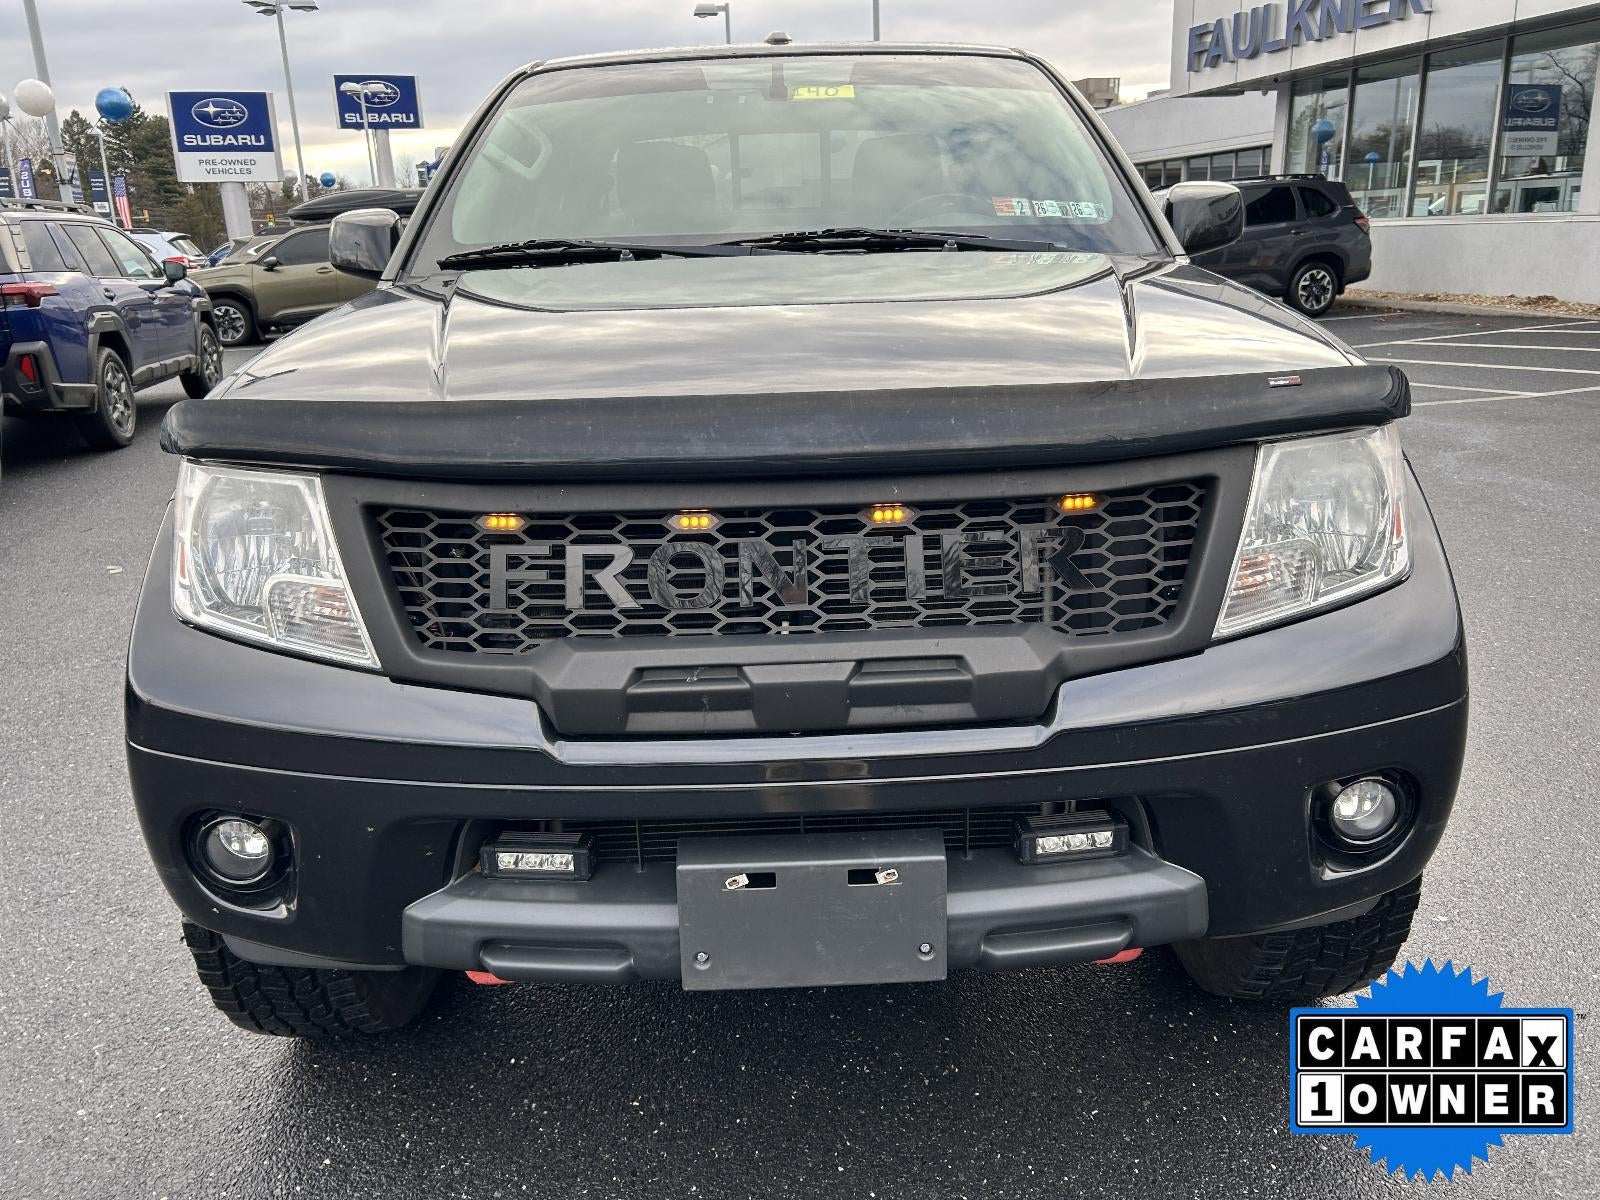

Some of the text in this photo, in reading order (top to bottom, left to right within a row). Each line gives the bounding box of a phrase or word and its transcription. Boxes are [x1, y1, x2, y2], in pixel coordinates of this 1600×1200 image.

[344, 113, 415, 123] SUBARU
[183, 134, 265, 146] SUBARU
[198, 158, 257, 166] PRE-OWNED
[204, 167, 252, 175] VEHICLES
[1035, 202, 1047, 215] 26
[1071, 203, 1084, 216] 26
[489, 525, 1099, 611] FRONTIER
